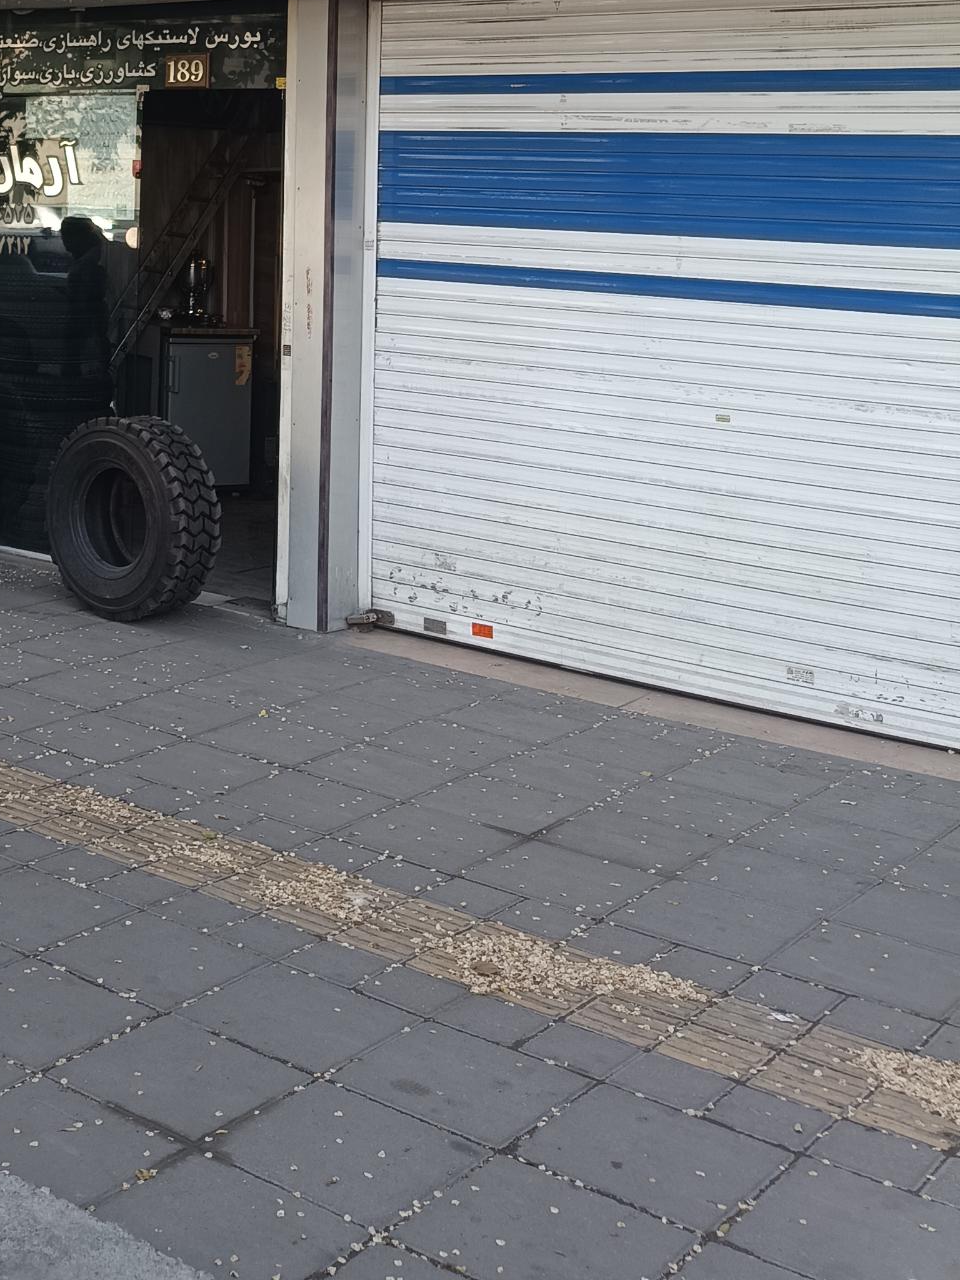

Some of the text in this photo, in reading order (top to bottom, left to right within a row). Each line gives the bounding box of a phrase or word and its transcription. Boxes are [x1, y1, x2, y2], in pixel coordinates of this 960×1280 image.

[117, 25, 200, 51] لاستیکهای
[205, 30, 261, 49] بورس
[167, 59, 204, 83] 189
